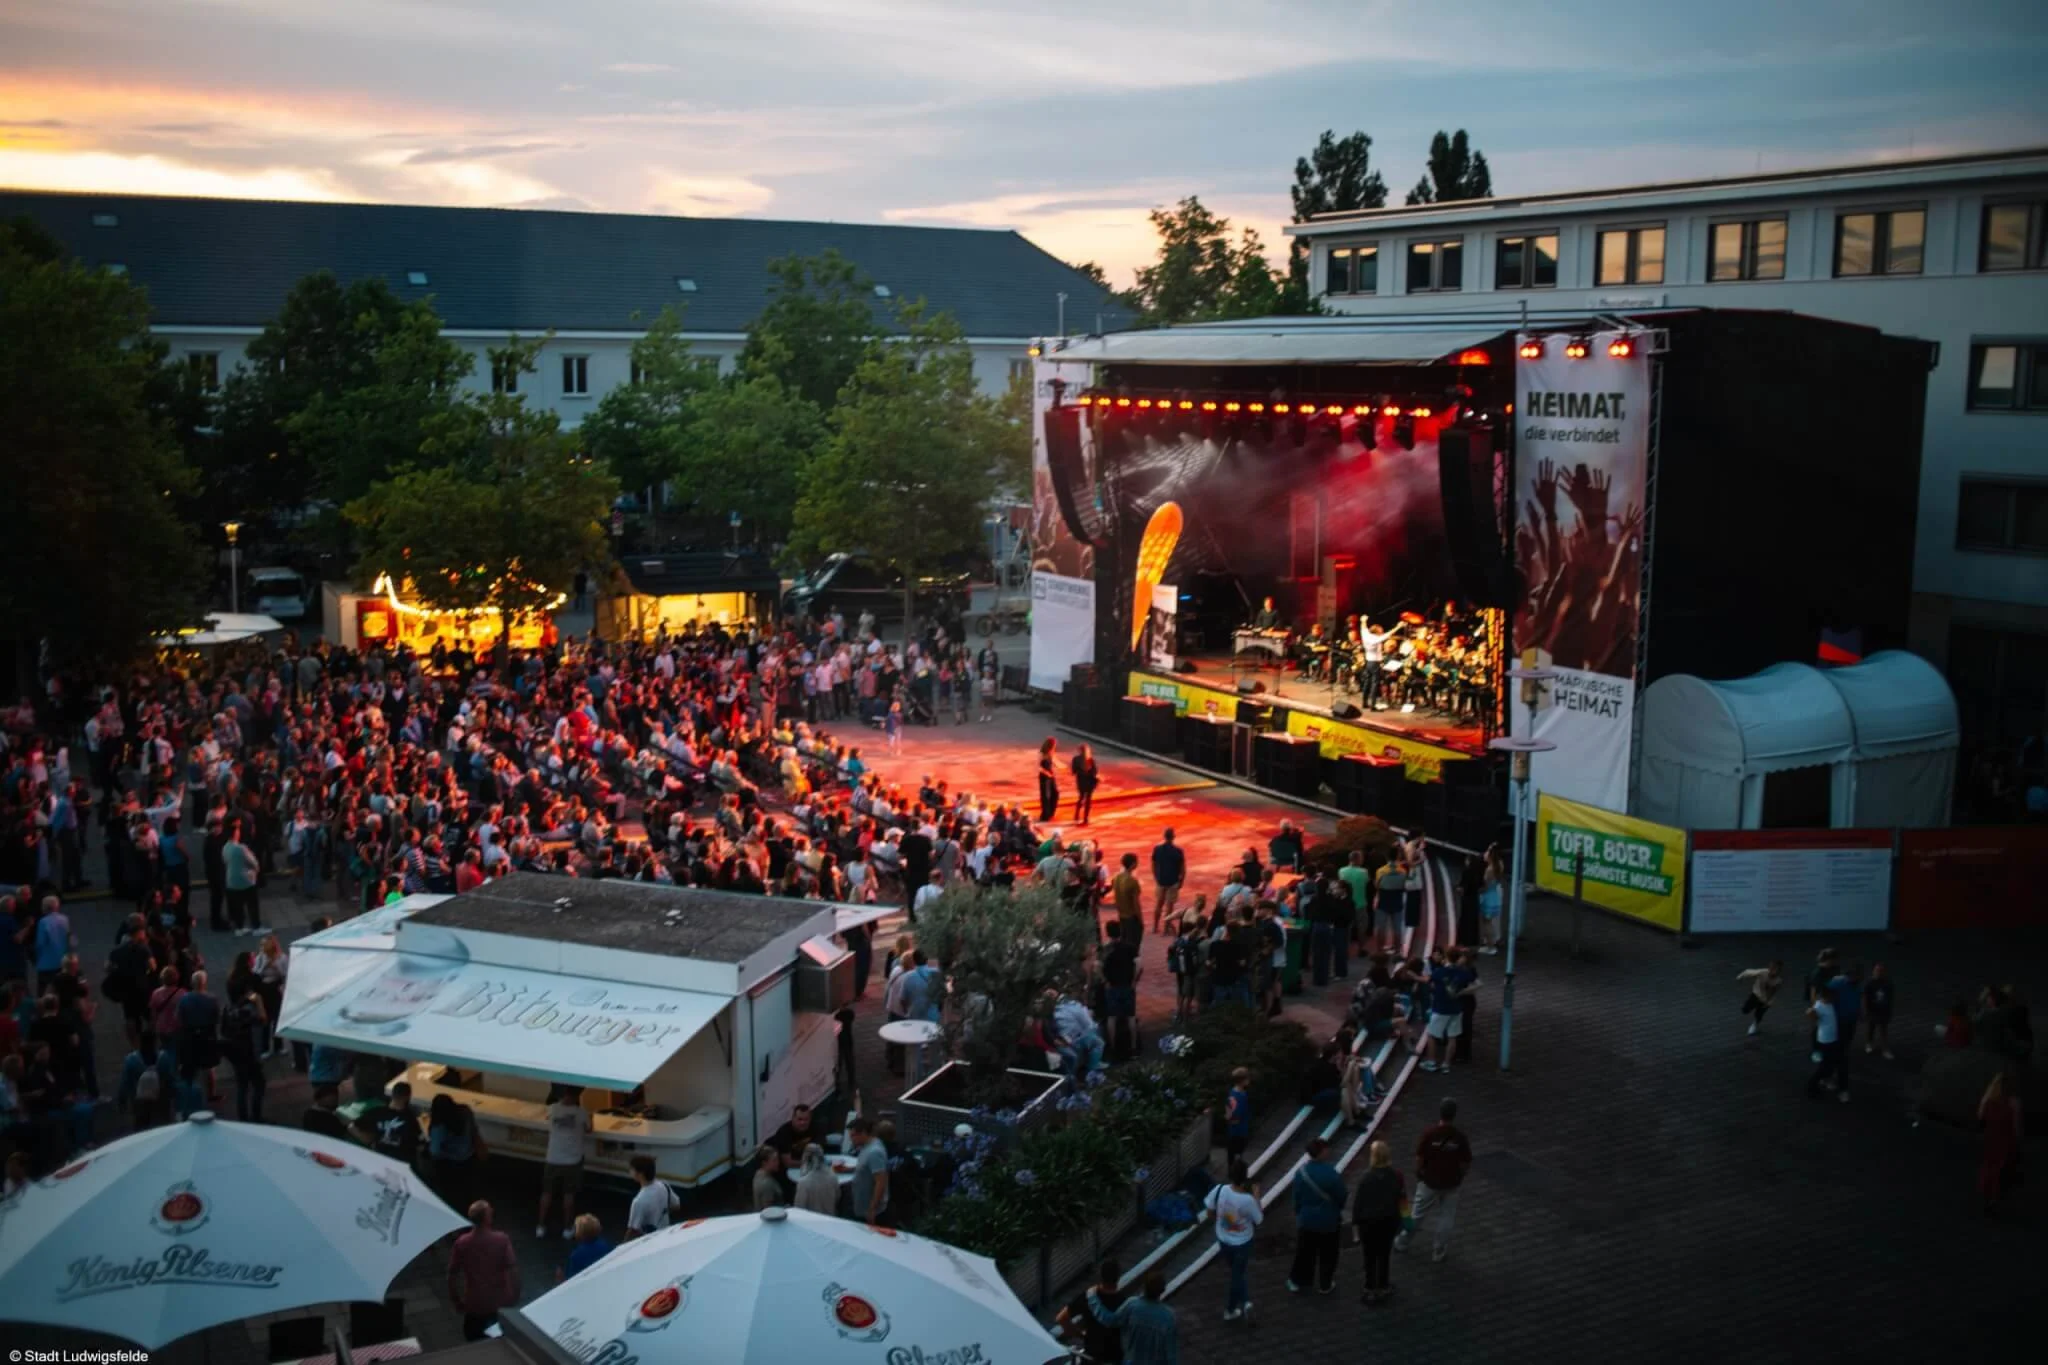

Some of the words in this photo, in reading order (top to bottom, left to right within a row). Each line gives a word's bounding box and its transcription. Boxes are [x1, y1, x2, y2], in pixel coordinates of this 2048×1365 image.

[1526, 391, 1625, 421] HEIMAT,
[1525, 425, 1545, 441] die
[1551, 426, 1620, 443] verbindet
[1554, 688, 1622, 719] HEIMAT
[1603, 839, 1657, 871] 80ER.
[446, 979, 682, 1049] Bitburger
[56, 1254, 161, 1294] König
[155, 1243, 284, 1285] Pilsener
